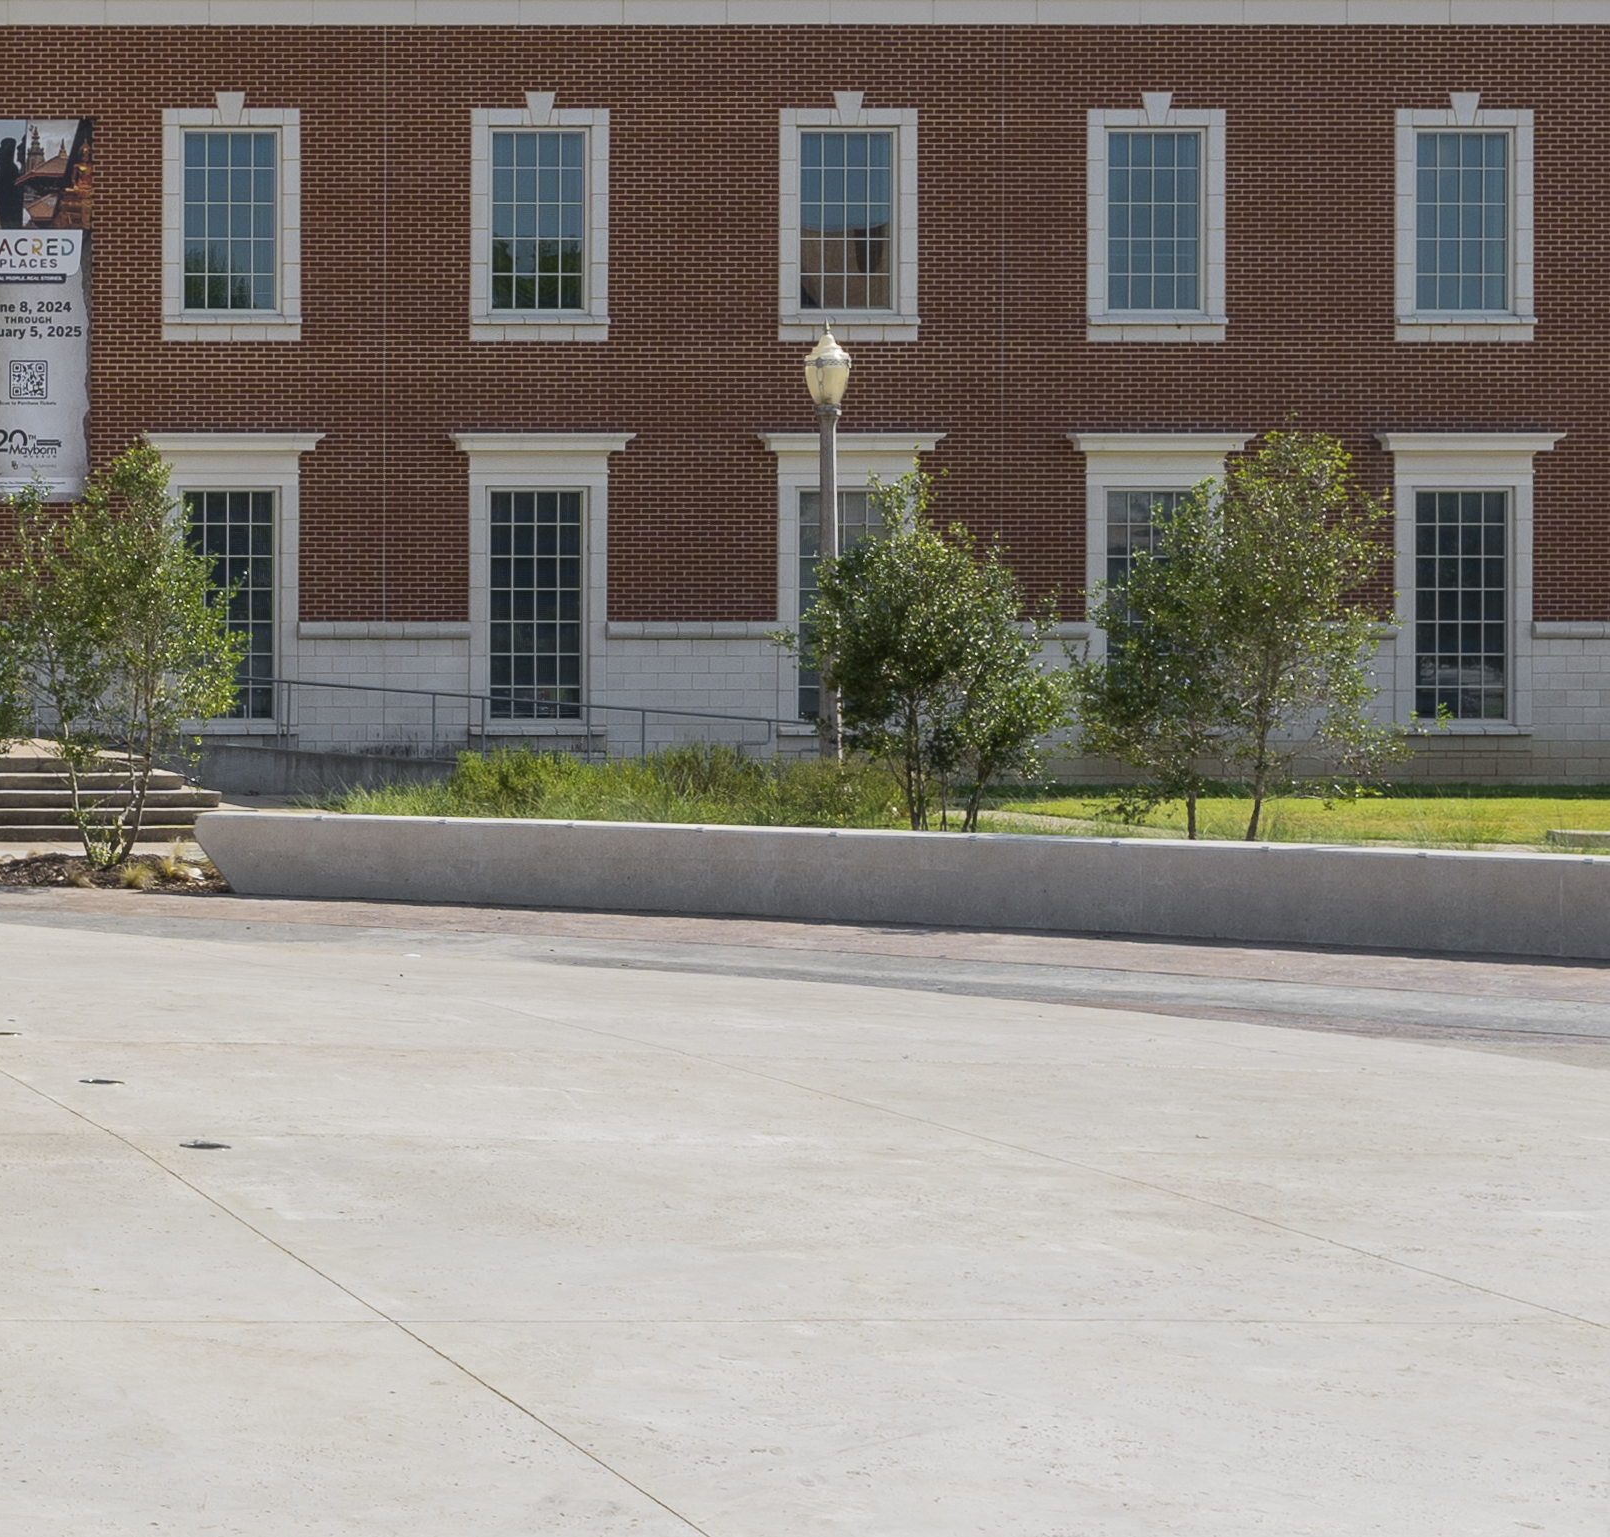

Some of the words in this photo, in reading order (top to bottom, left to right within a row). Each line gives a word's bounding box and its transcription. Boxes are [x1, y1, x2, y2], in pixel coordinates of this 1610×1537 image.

[0, 259, 58, 269] PLACES
[19, 301, 32, 314] 8,
[37, 301, 72, 313] 2024
[4, 316, 52, 324] THROUGH
[30, 326, 42, 339] 5,
[47, 326, 82, 337] 2025
[8, 443, 57, 455] Mayborn
